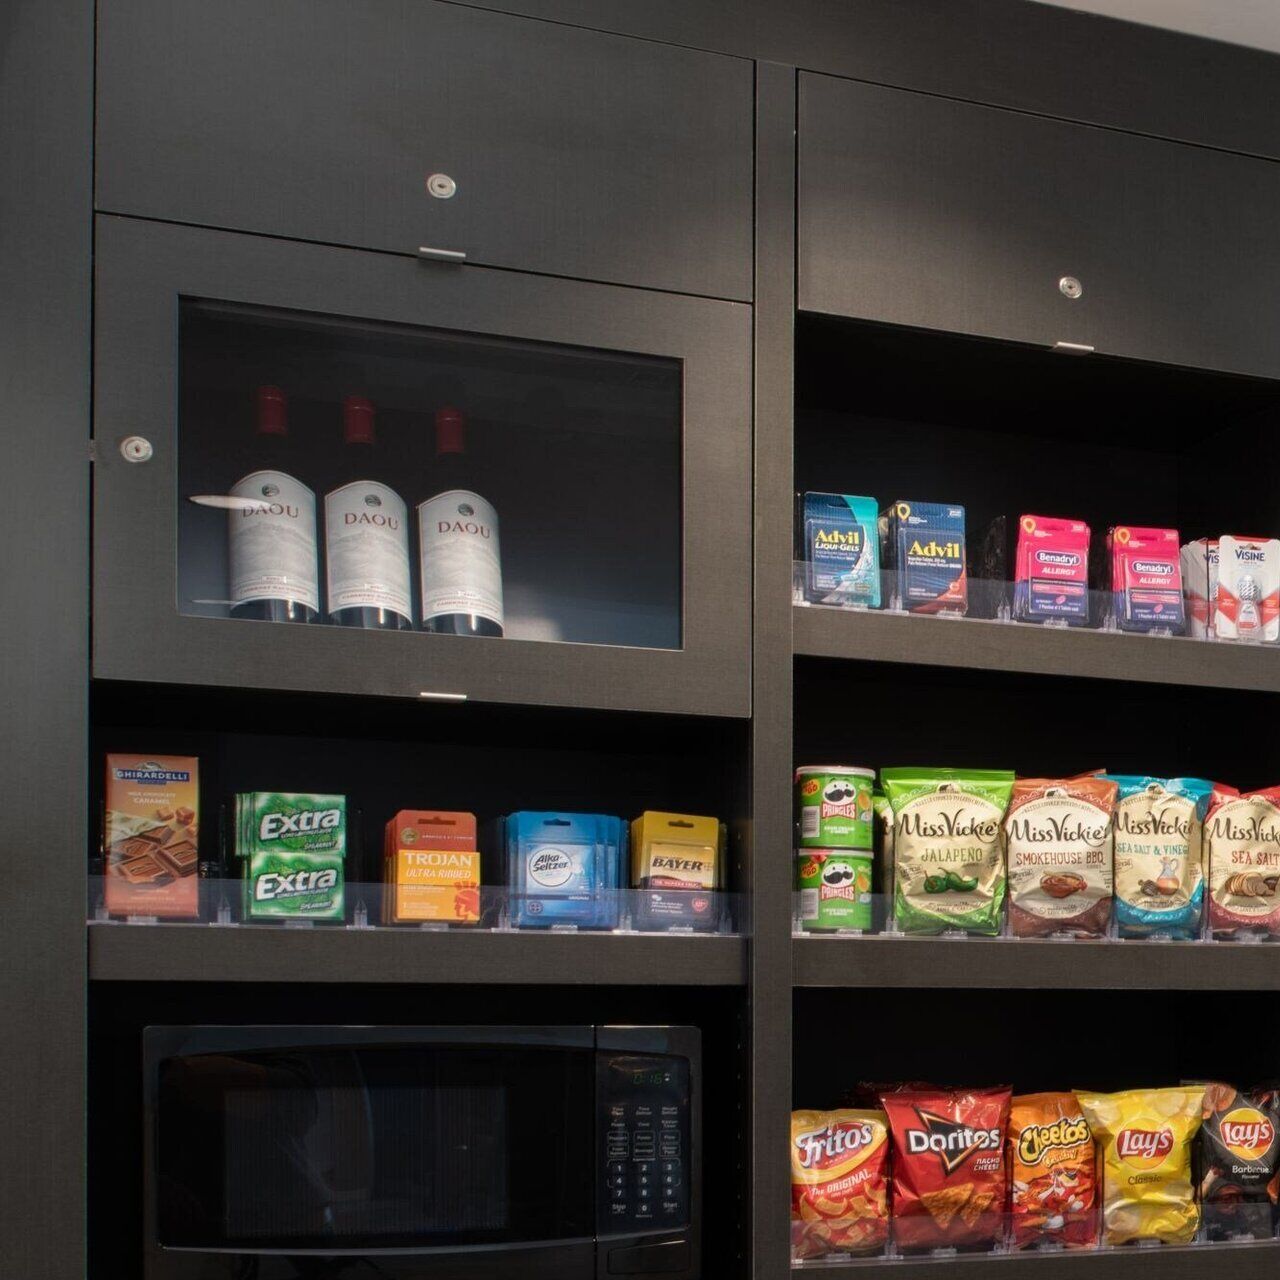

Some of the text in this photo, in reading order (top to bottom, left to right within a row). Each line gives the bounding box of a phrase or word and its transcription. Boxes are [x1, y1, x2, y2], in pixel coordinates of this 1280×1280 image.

[344, 512, 398, 530] DAOU
[438, 521, 490, 538] DAOU
[815, 530, 860, 544] Advil
[815, 543, 860, 551] LIQUI-GELS
[908, 540, 960, 558] Advil
[1040, 553, 1077, 566] Benadryl
[1235, 550, 1265, 562] VISINE
[1041, 567, 1076, 576] ALLERGY
[1135, 563, 1172, 575] Benadryl
[1139, 577, 1171, 585] ALLERGY
[117, 771, 187, 780] GHIRARDELLI
[822, 803, 856, 817] PRINGLES
[260, 809, 340, 840] Extra
[899, 812, 944, 837] Miss
[1112, 811, 1152, 835] Miss
[1210, 818, 1252, 841] Miss
[1009, 820, 1051, 843] Miss
[921, 847, 983, 862] JALAPEÑO
[1117, 843, 1161, 856] SEA SALT &
[405, 853, 472, 867] TROJAN
[652, 857, 703, 871] BAYER
[1016, 852, 1104, 865] SMOKEHOUSE BBQ
[1231, 851, 1280, 866] SEA SALT
[407, 868, 436, 877] ULTRA
[533, 861, 568, 872] Seltzer
[256, 869, 337, 900] Extra
[821, 886, 855, 900] PRINGLES
[1224, 1119, 1271, 1145] Lay's
[796, 1124, 873, 1168] Fritos
[909, 1128, 1000, 1152] Doritos
[1019, 1119, 1090, 1163] Cheetos
[1120, 1128, 1174, 1159] Lay's
[974, 1164, 1000, 1172] CHEESE
[1232, 1165, 1269, 1174] Barbecue
[812, 1170, 872, 1197] The ORIGINAL
[1128, 1174, 1162, 1186] Classic
